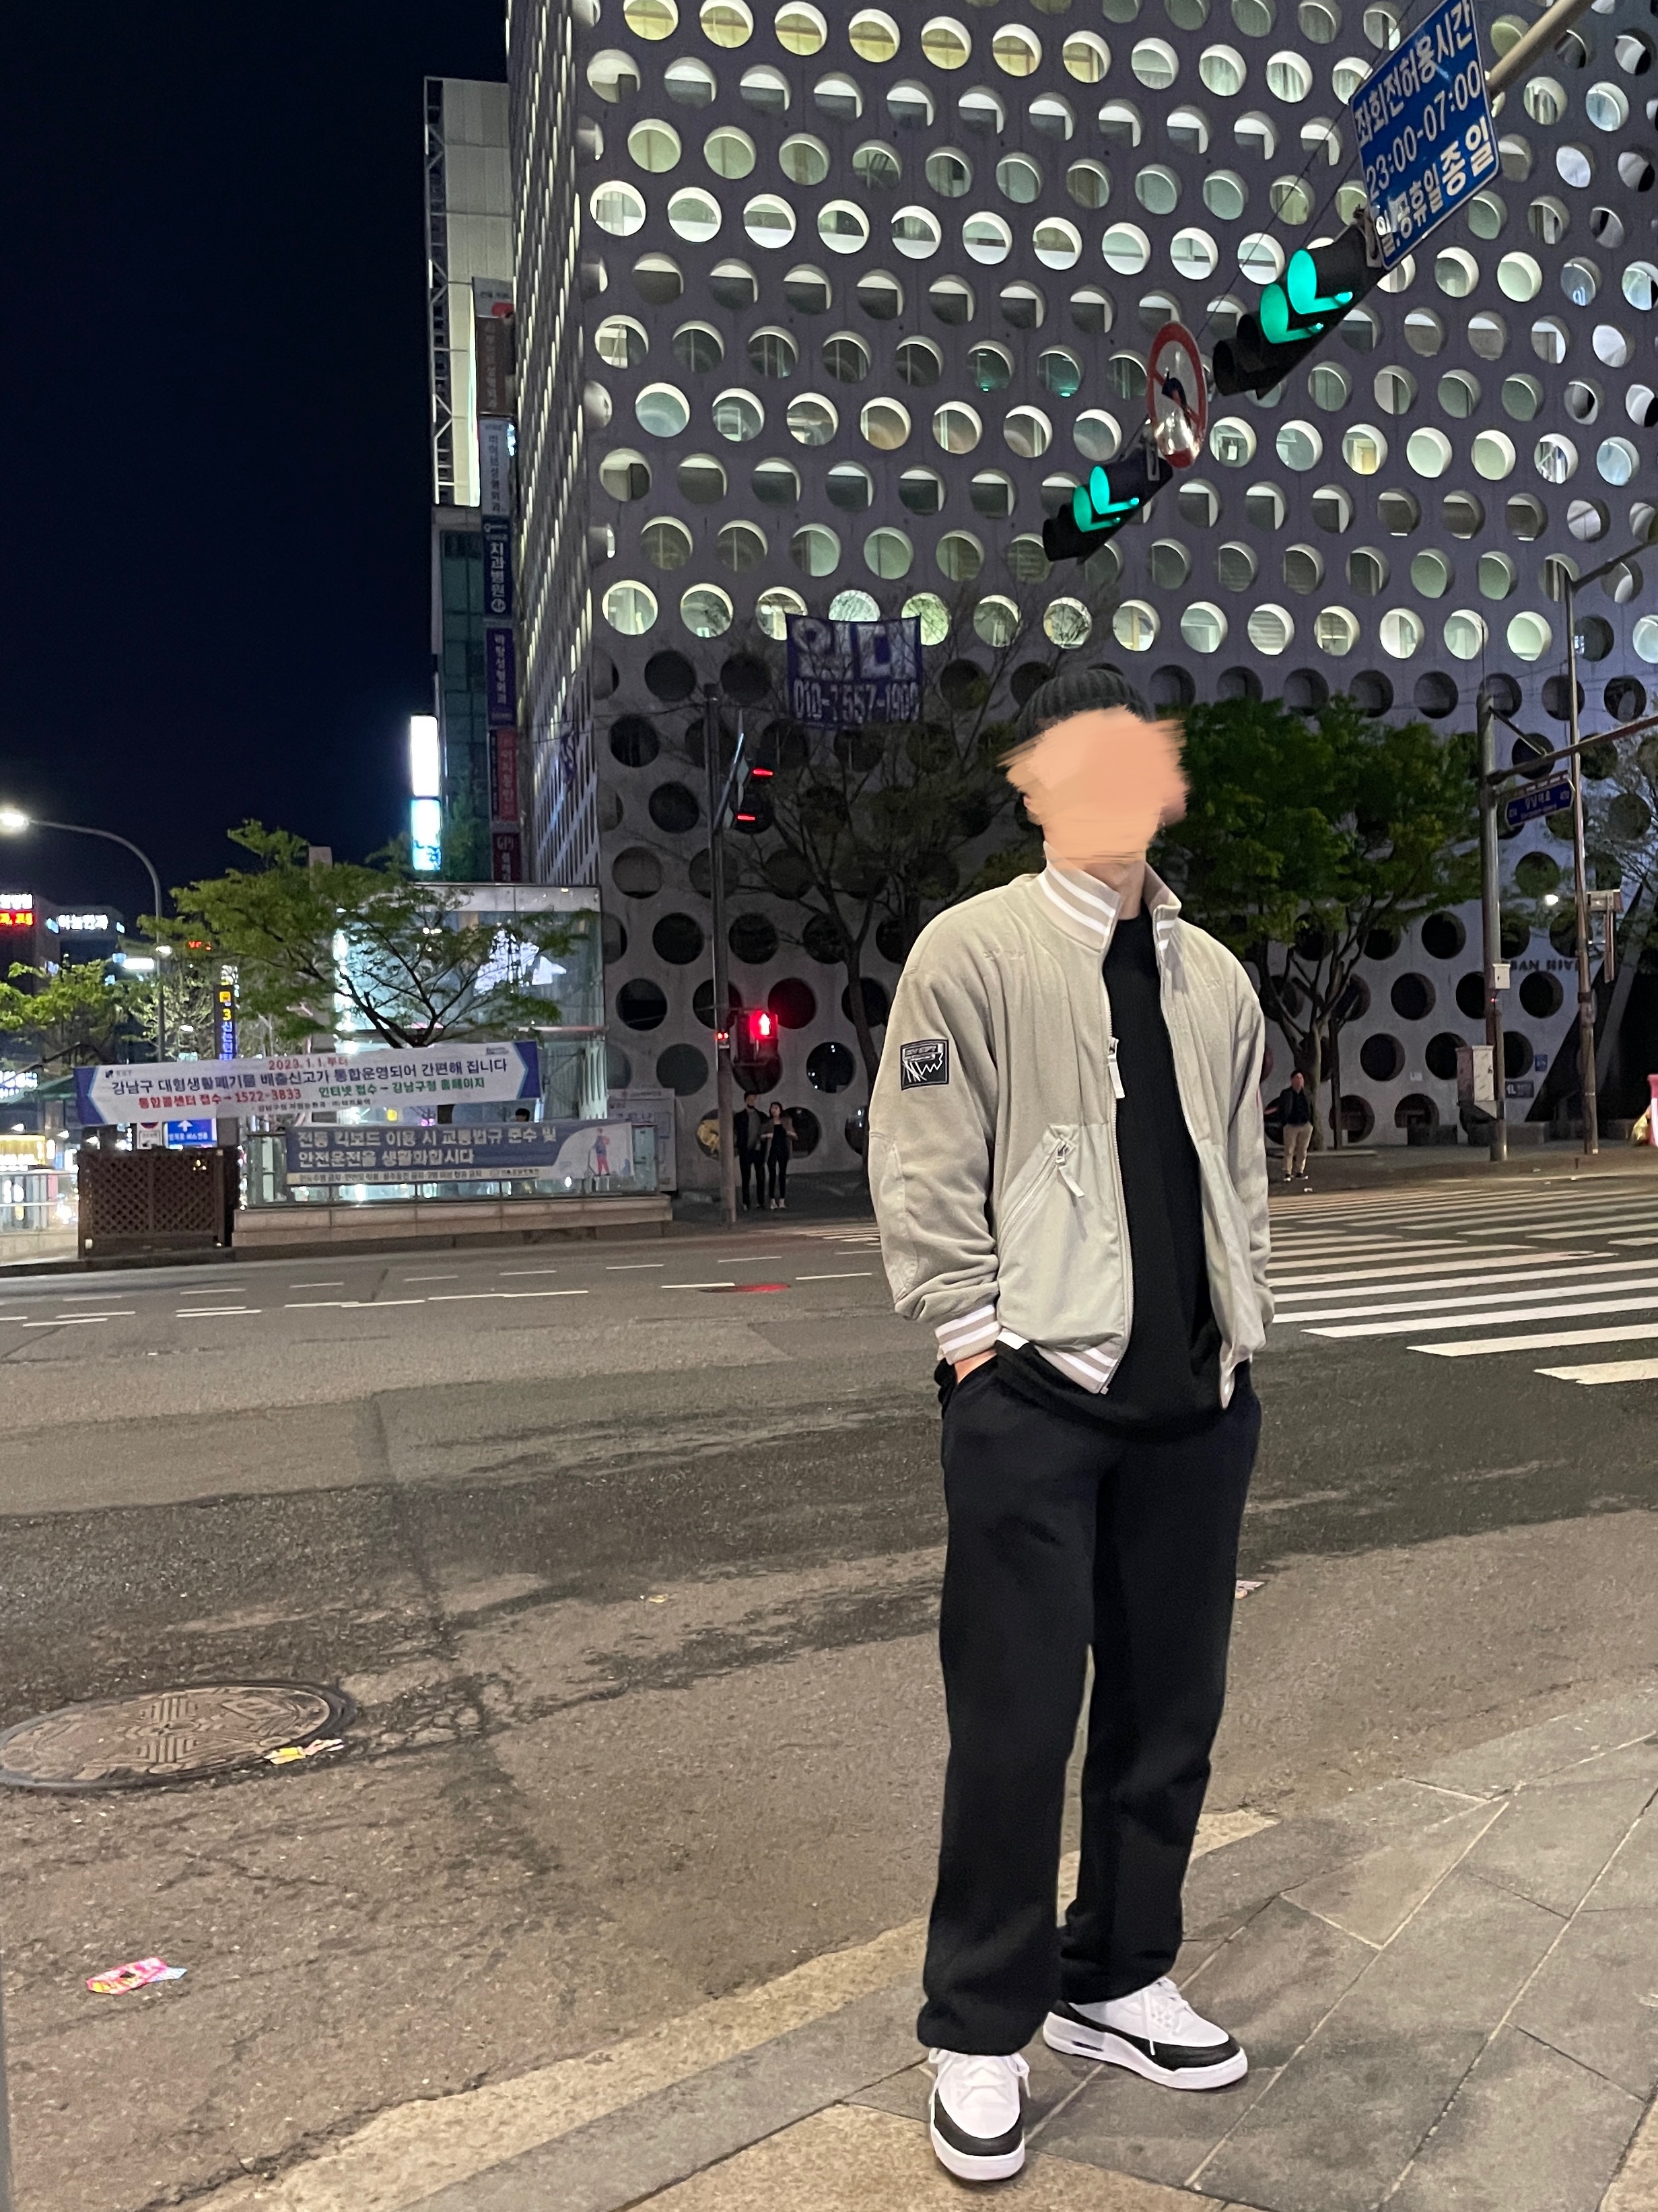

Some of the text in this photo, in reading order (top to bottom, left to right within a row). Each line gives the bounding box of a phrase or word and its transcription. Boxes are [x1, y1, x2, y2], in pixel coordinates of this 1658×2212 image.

[1355, 0, 1473, 147] 좌회전허용시간
[1367, 60, 1480, 201] 23:00-07:00
[112, 1059, 508, 1095] 강남구 대형생활폐기물 배출신고가 통합운영되어 간편해 집니다
[319, 1077, 485, 1098] 인터넷 접수 강남구청 홈페이지
[236, 1088, 302, 1103] 1522-3833
[298, 1126, 557, 1147] 전동 킥보드 이용 시 교통법규 준수 및
[299, 1148, 475, 1168] 안전운전을 생활화합시다
